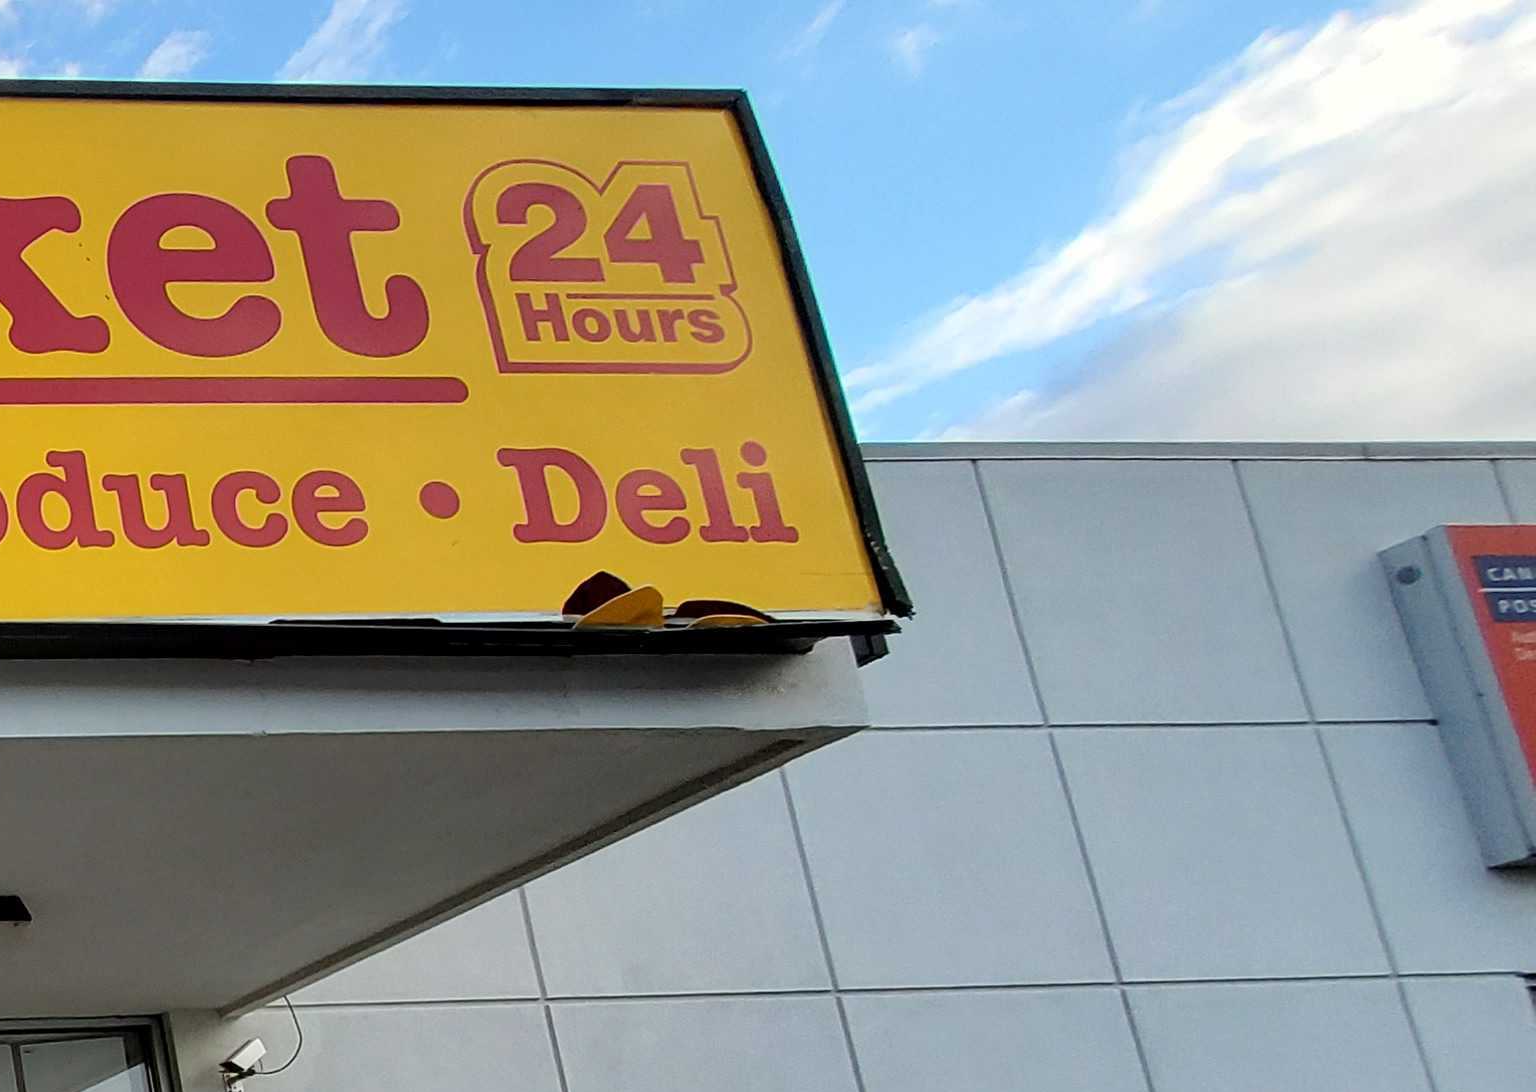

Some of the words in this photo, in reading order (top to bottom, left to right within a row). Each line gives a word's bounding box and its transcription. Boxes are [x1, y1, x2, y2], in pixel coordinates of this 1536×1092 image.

[494, 181, 706, 284] 24
[514, 291, 727, 346] Hours
[496, 439, 801, 547] Deli
